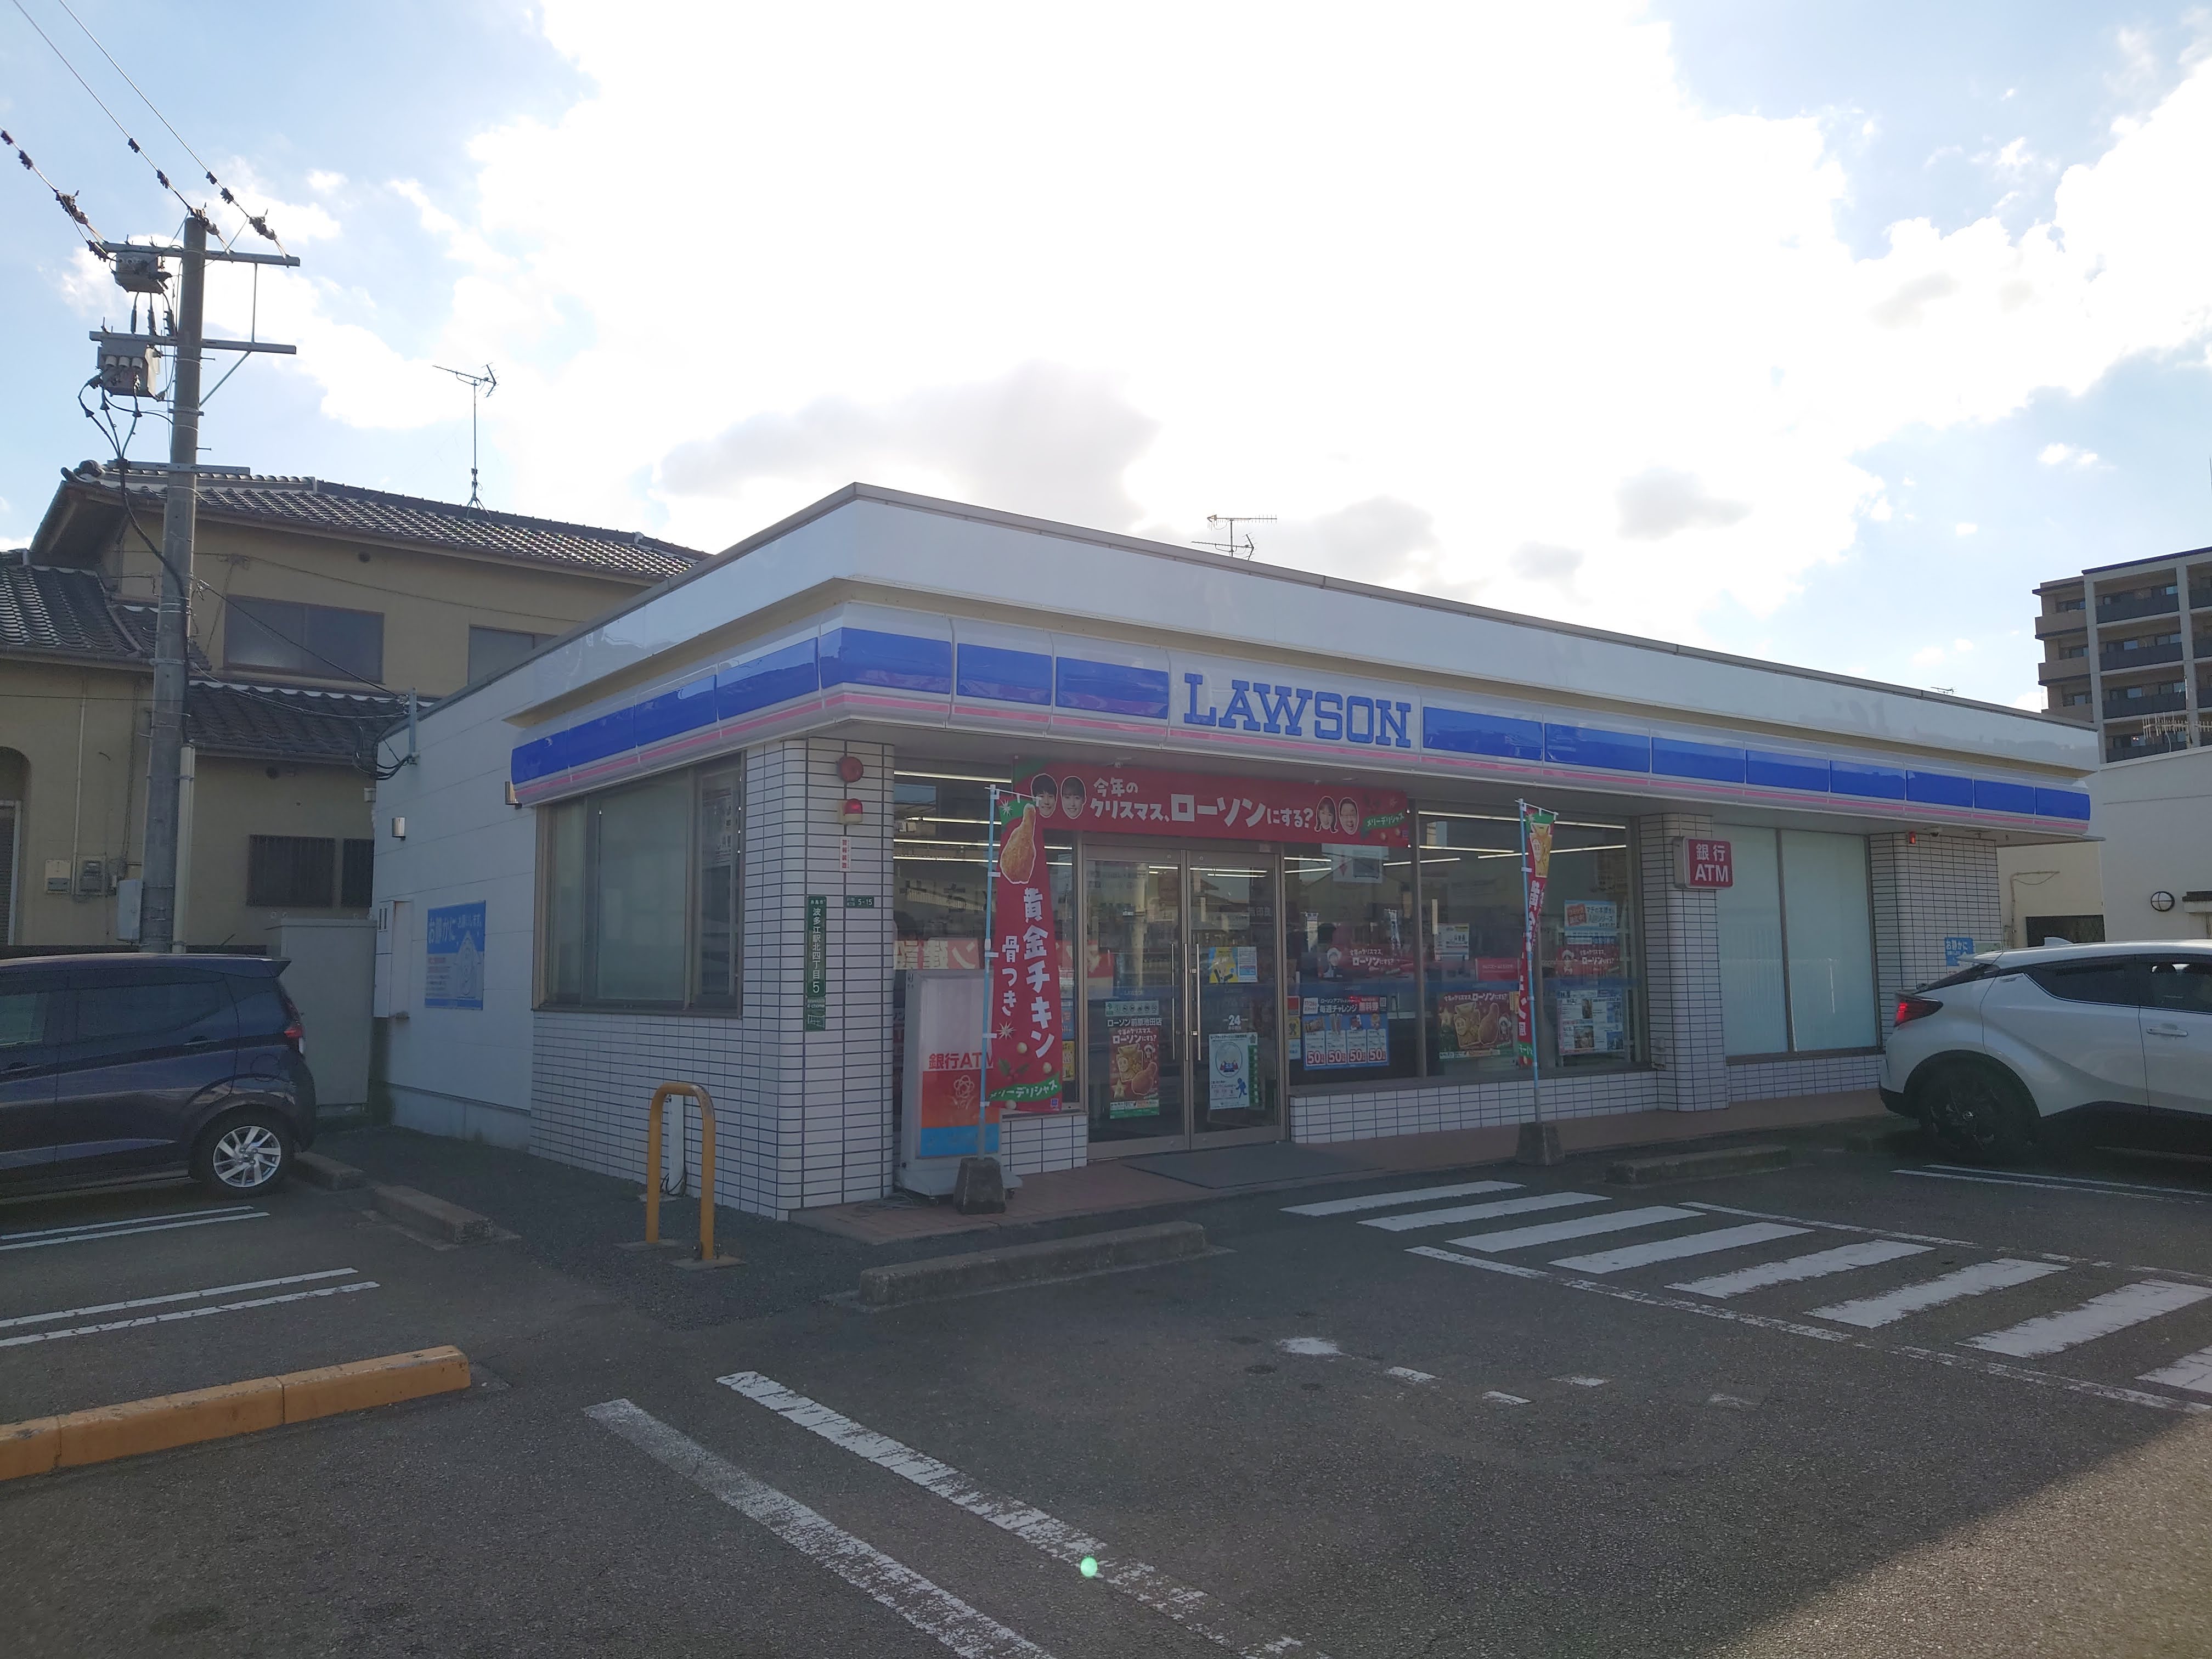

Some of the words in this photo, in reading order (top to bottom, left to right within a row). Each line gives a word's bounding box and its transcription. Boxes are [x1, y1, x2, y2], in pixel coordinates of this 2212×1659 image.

[1184, 673, 1411, 748] LAWSON
[1093, 777, 1138, 797] 今年の
[1695, 843, 1725, 862] 銀行
[1695, 864, 1729, 882] ATM
[1002, 935, 1020, 1016] 骨つき
[1023, 887, 1054, 1058] 黄金チキン
[1319, 1005, 1358, 1013] 毎週チャレンジ
[1108, 1018, 1163, 1027] ローソン前原池田店
[1229, 1014, 1241, 1025] 24
[989, 1079, 1058, 1098] メリーデリシャス
